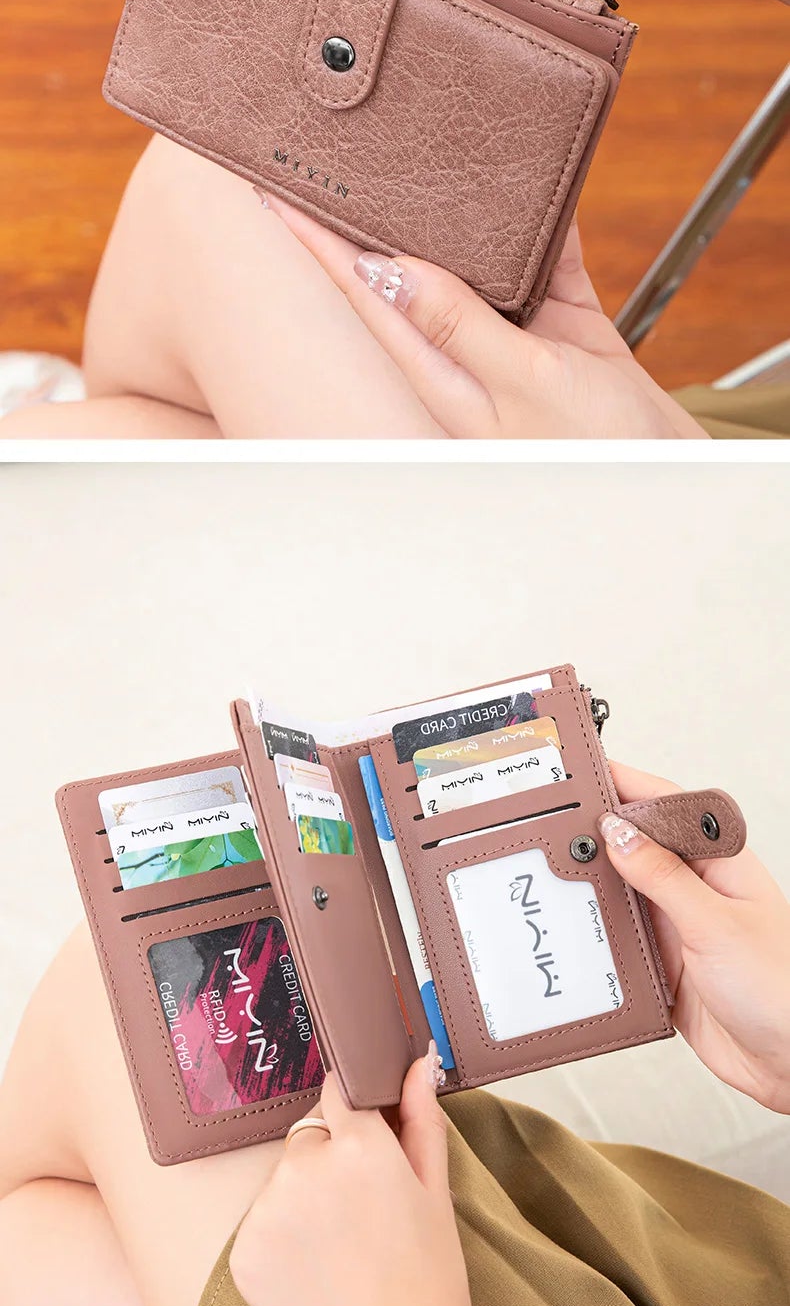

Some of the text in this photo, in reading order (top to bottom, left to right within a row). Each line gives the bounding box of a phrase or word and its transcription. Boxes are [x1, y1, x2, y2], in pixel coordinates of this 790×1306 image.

[273, 147, 350, 199] MIYIN
[441, 772, 484, 791] MIYIN
[497, 757, 540, 776] MIYIN
[131, 821, 174, 838] MIYIN
[187, 810, 230, 827] MIYIN
[200, 993, 216, 1035] Protection
[208, 989, 227, 1022] RFID
[223, 948, 279, 1073] MIYIN
[278, 954, 312, 1042] CREDIT CARD
